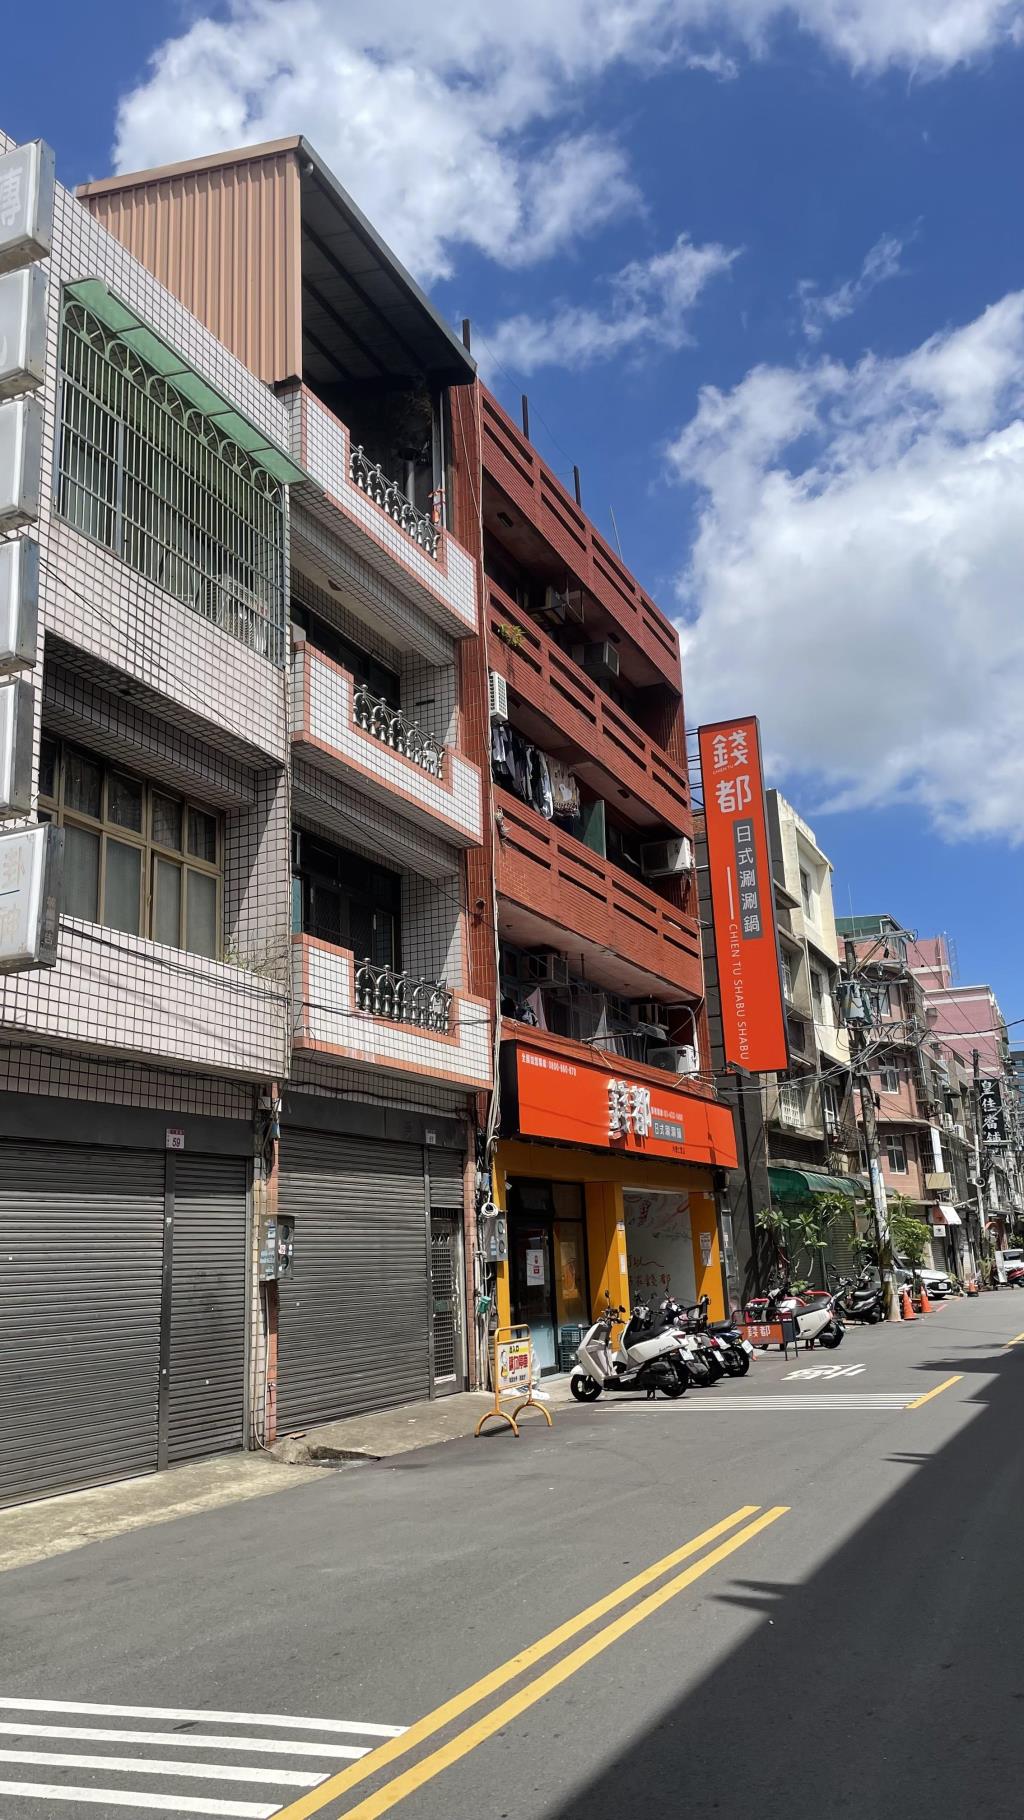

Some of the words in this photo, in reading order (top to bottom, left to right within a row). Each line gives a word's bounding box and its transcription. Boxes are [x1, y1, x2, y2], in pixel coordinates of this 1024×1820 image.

[712, 729, 752, 814] 錢都
[736, 825, 760, 933] 日式涮涮鍋
[729, 923, 741, 958] CHIEN
[732, 961, 741, 976] TU
[734, 979, 745, 1017] SHABU
[737, 1021, 750, 1060] SHABU
